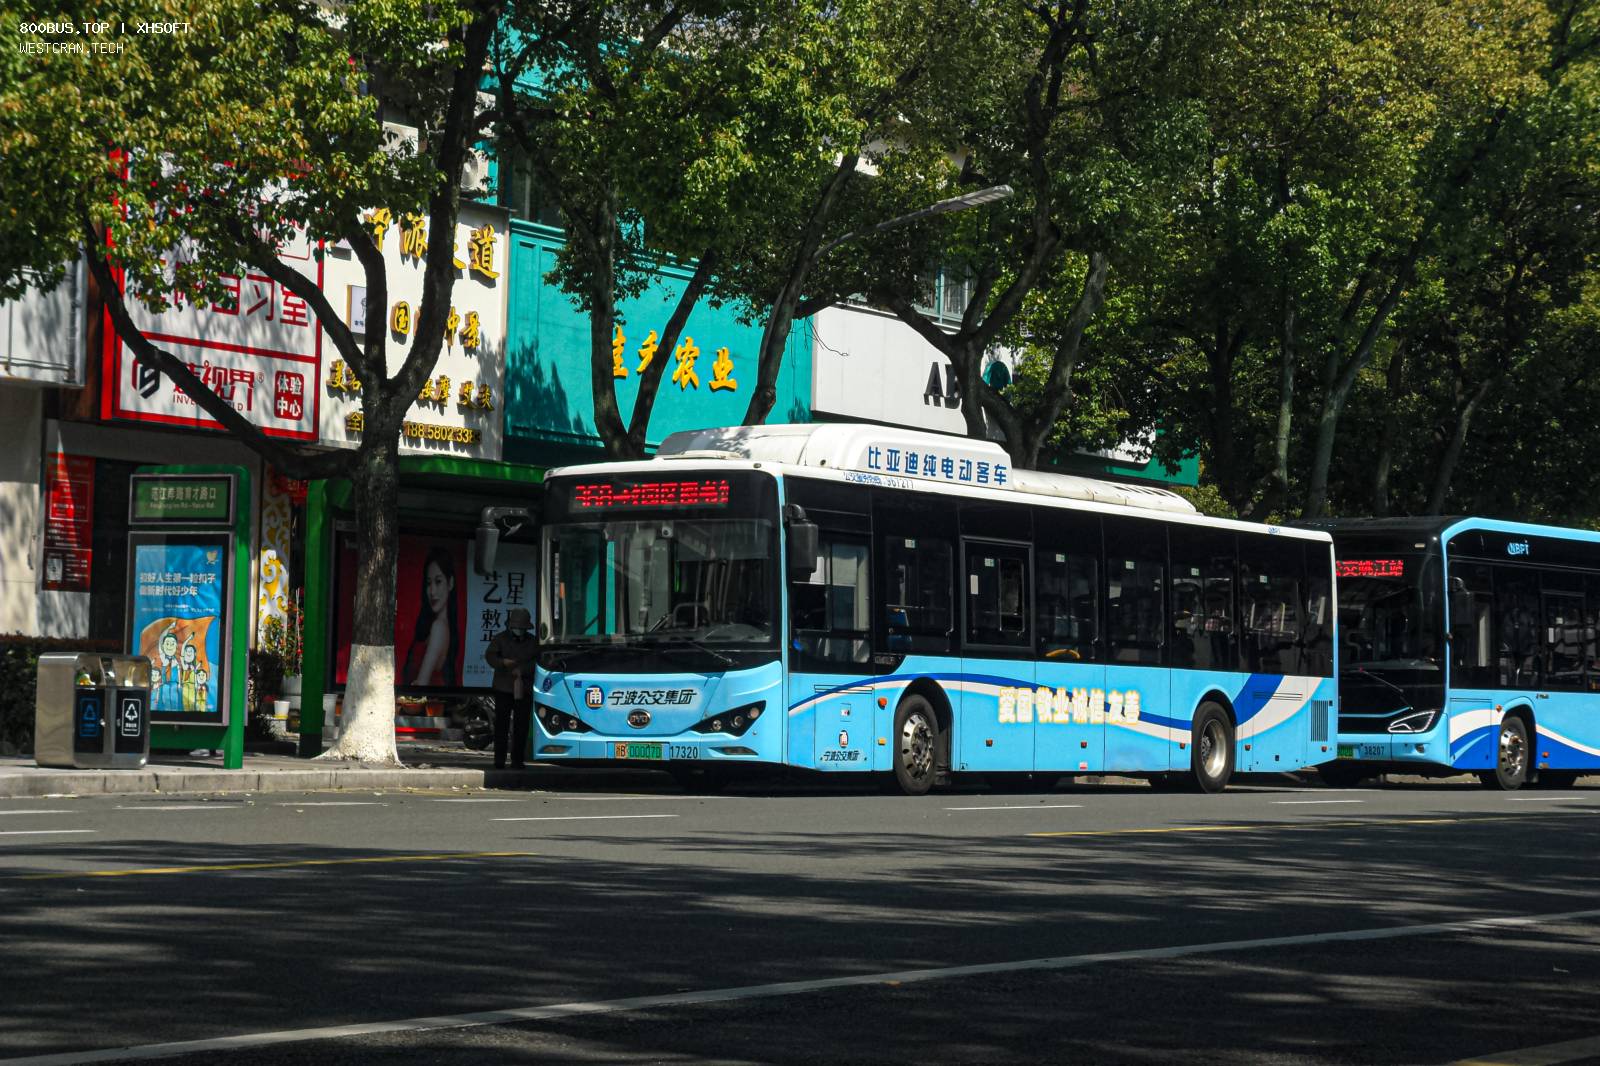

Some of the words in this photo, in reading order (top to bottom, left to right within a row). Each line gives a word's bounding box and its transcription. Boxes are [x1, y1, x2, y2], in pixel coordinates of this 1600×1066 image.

[277, 374, 303, 396] 体验
[277, 396, 302, 418] 中心
[868, 446, 1007, 485] 比亚迪纯电动客车
[608, 688, 697, 706] 宁波公交集团
[670, 746, 698, 760] 17320
